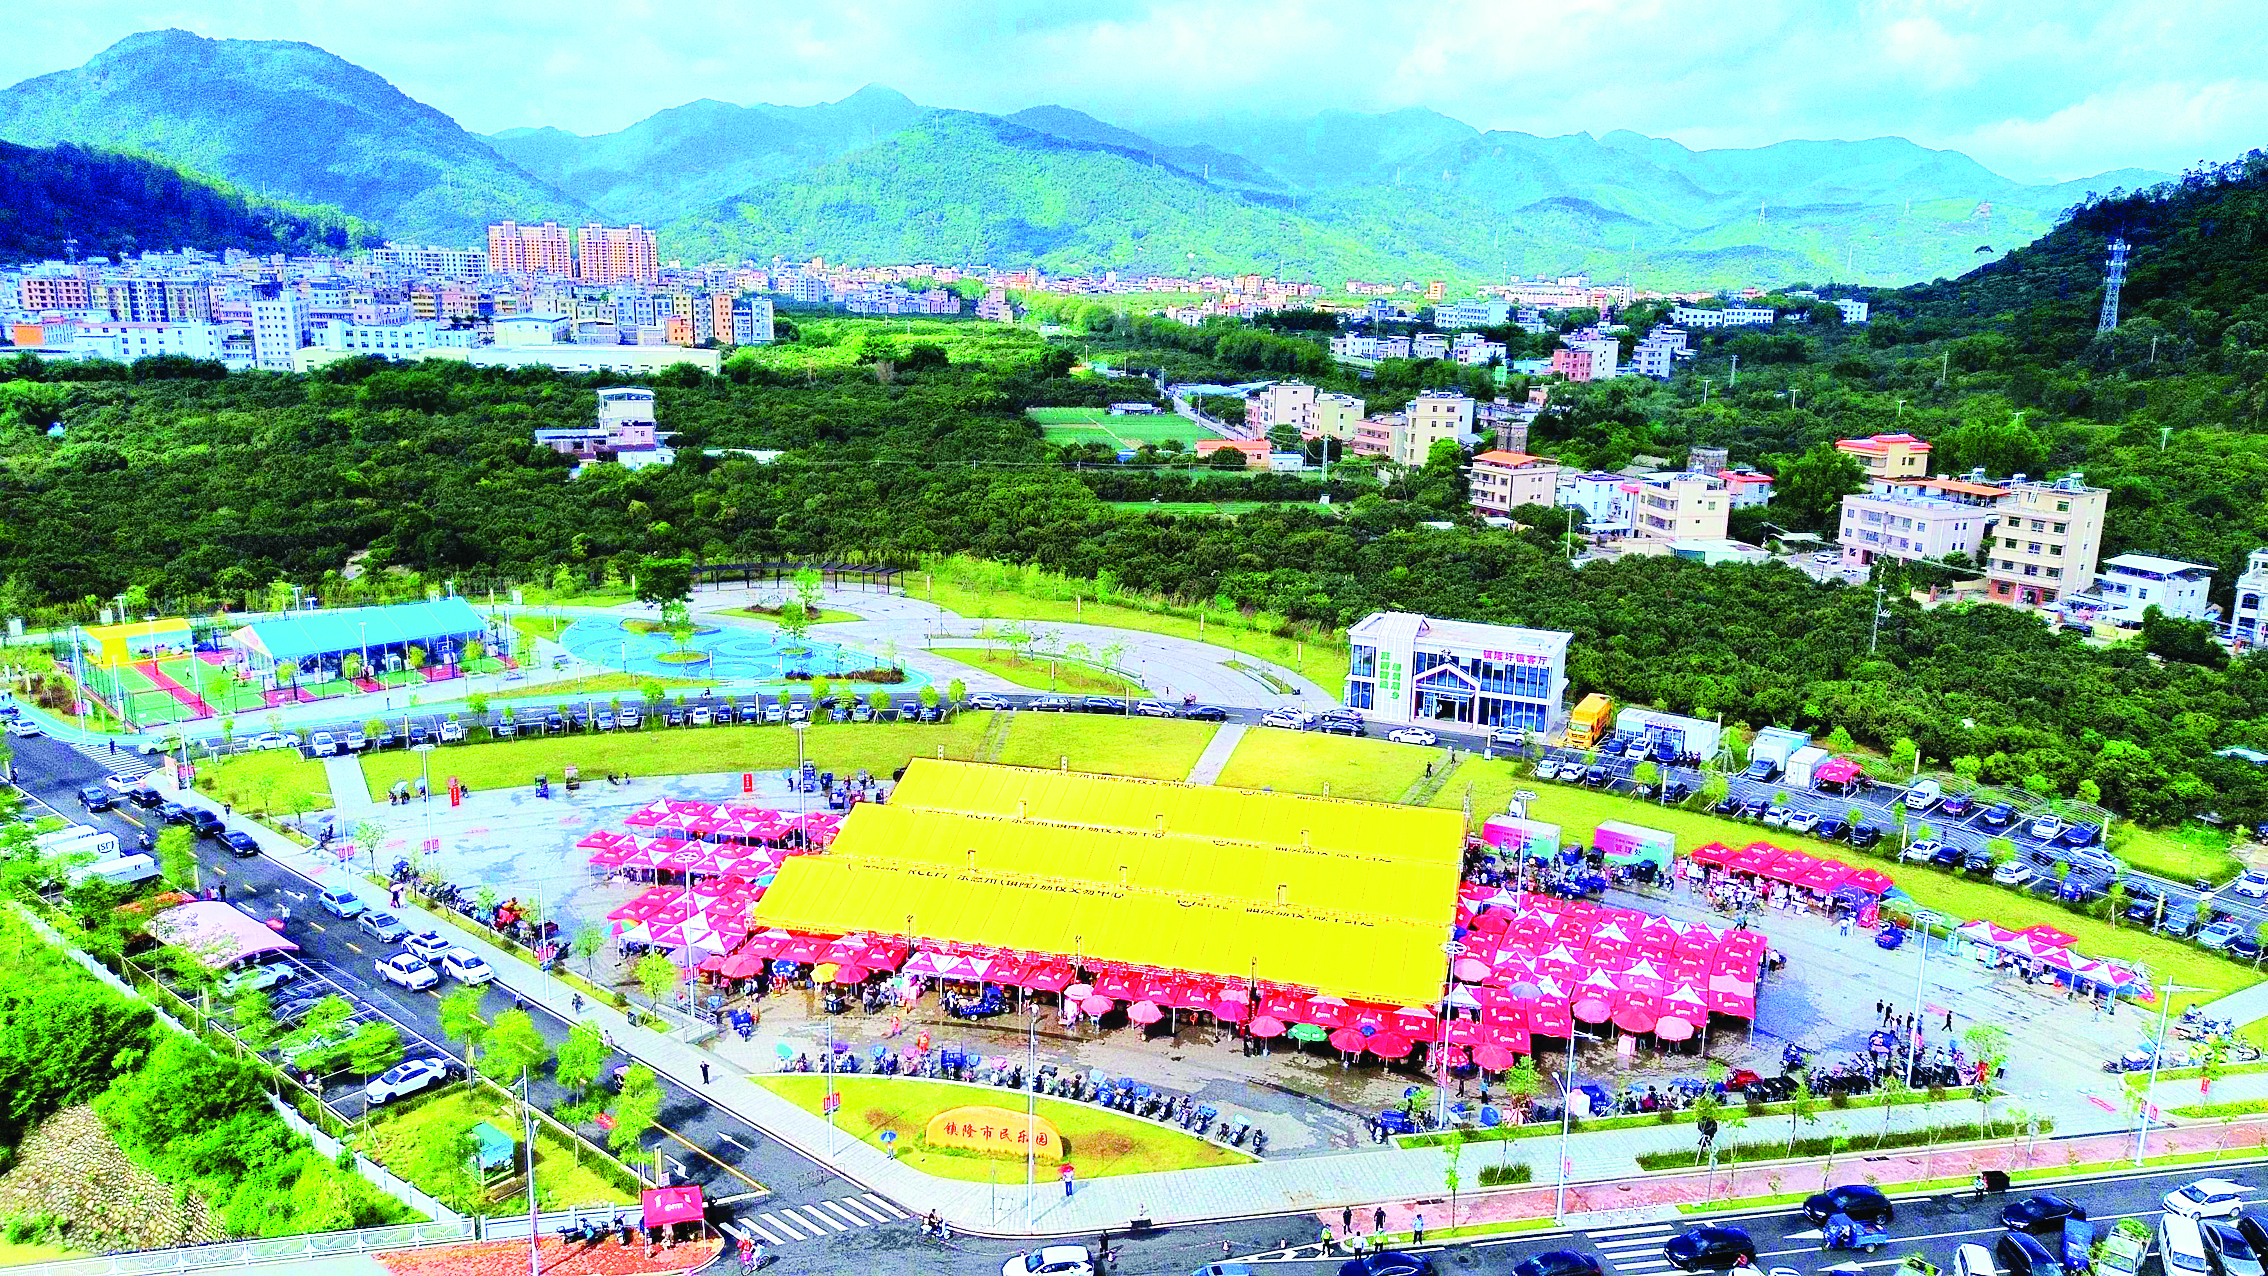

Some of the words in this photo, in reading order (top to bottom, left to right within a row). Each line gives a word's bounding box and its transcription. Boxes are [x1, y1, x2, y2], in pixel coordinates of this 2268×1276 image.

[943, 1121, 1048, 1146] 镇隆市民乐园
